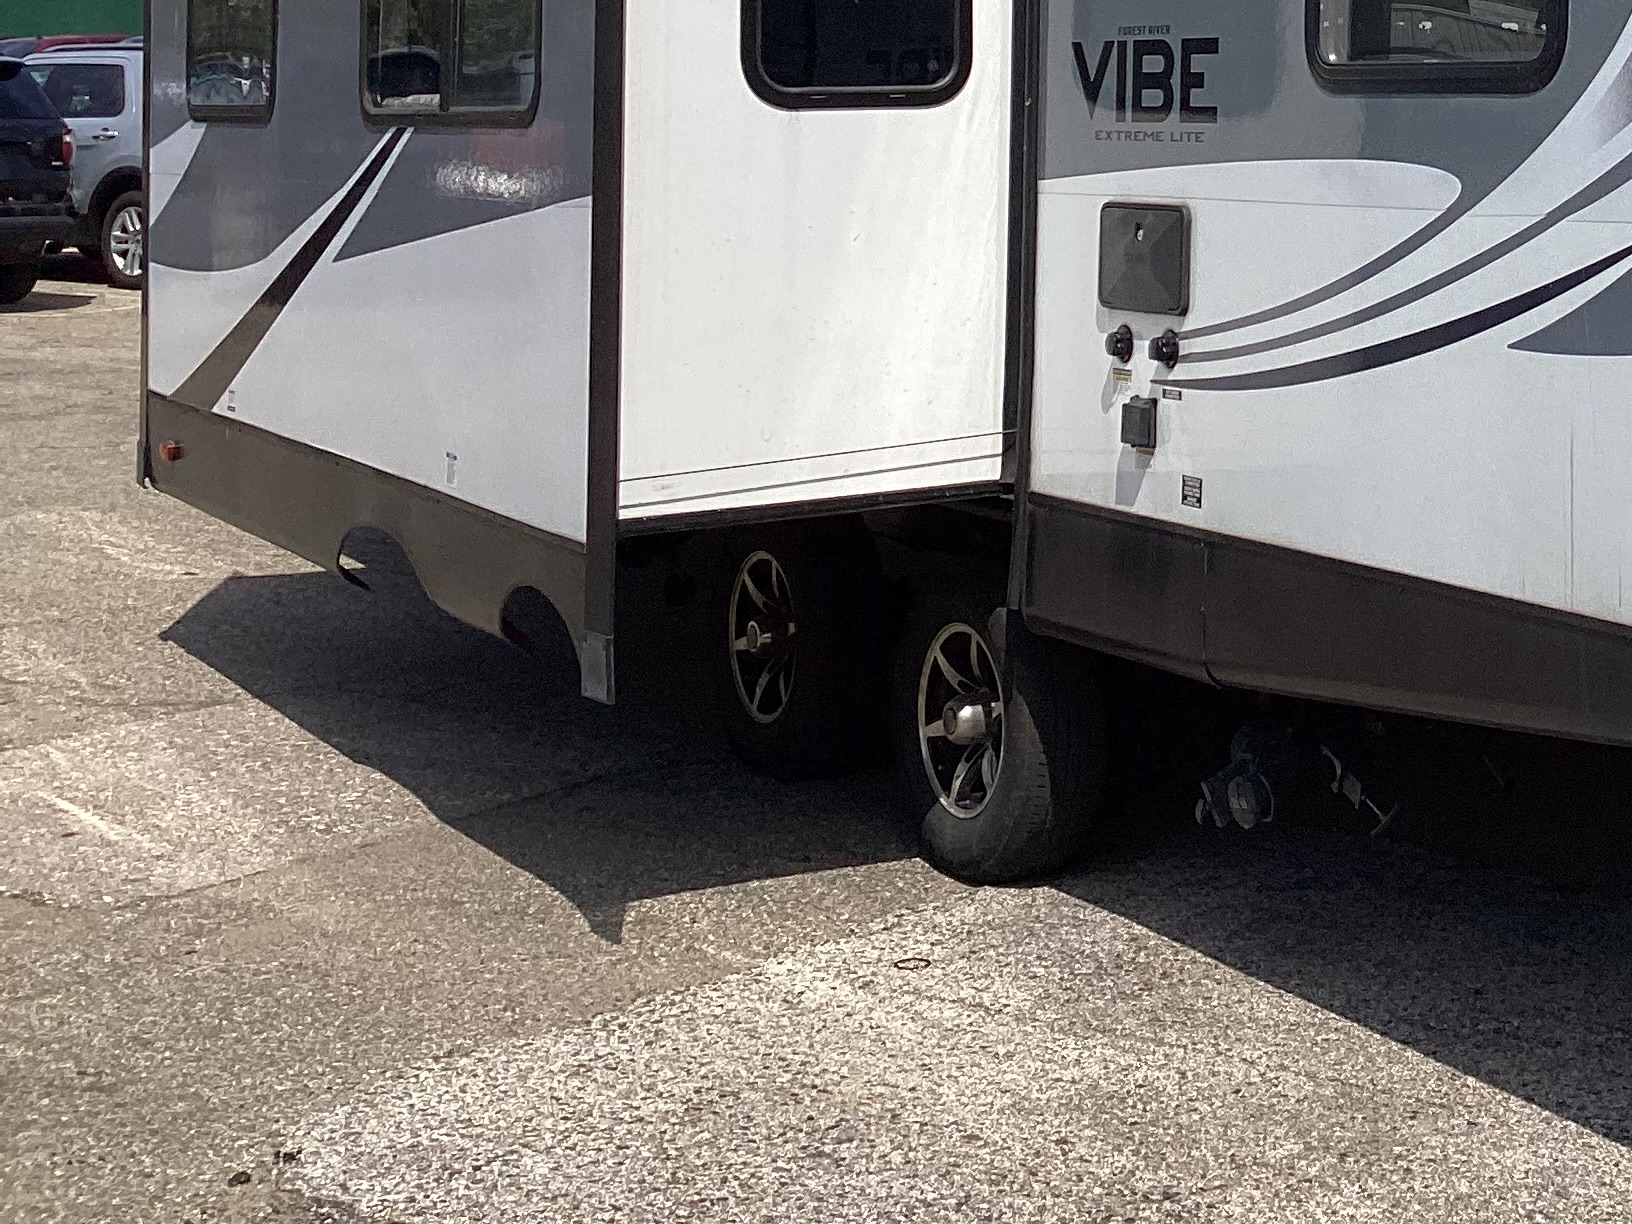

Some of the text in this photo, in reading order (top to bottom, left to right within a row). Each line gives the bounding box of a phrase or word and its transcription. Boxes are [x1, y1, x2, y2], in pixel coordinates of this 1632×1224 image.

[1117, 24, 1171, 36] FOREST RIVER
[1072, 37, 1219, 123] VIBE
[1095, 130, 1206, 143] EXTREME LITE
